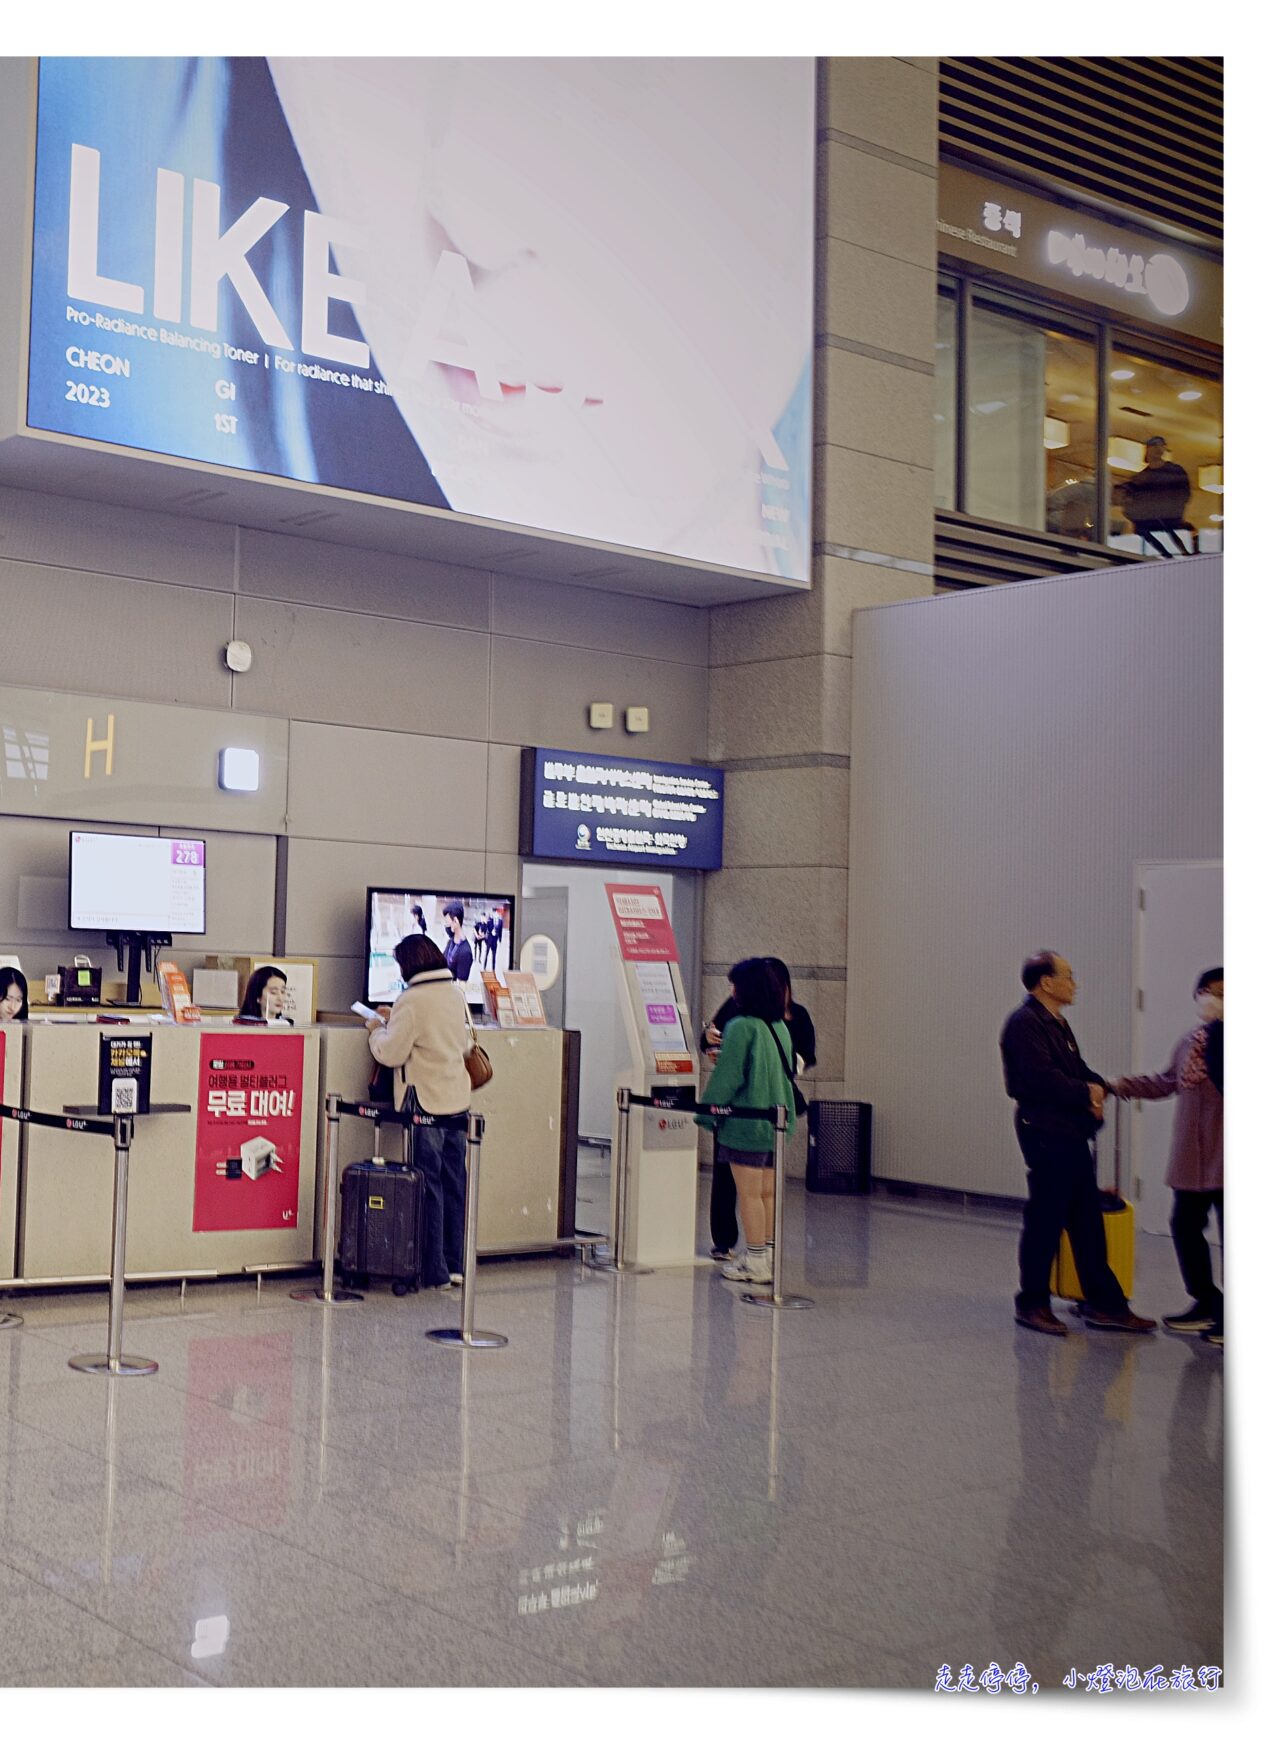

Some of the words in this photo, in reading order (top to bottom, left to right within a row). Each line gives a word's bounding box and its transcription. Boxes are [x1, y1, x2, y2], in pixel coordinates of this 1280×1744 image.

[67, 142, 370, 369] LIKE
[65, 346, 131, 378] CHEON
[215, 379, 237, 401] GI
[66, 305, 158, 341] Pro-Radiance
[159, 327, 221, 359] Balancing
[223, 341, 259, 366] Toner
[275, 355, 296, 374] For
[297, 361, 351, 387] radiance
[351, 375, 375, 393] that
[64, 380, 111, 409] 2023
[214, 413, 238, 434] 1ST
[84, 714, 116, 779] H
[175, 849, 200, 865] 278
[207, 1090, 248, 1118] 무료
[250, 1089, 295, 1117] 대여!
[208, 1075, 238, 1089] 여행용
